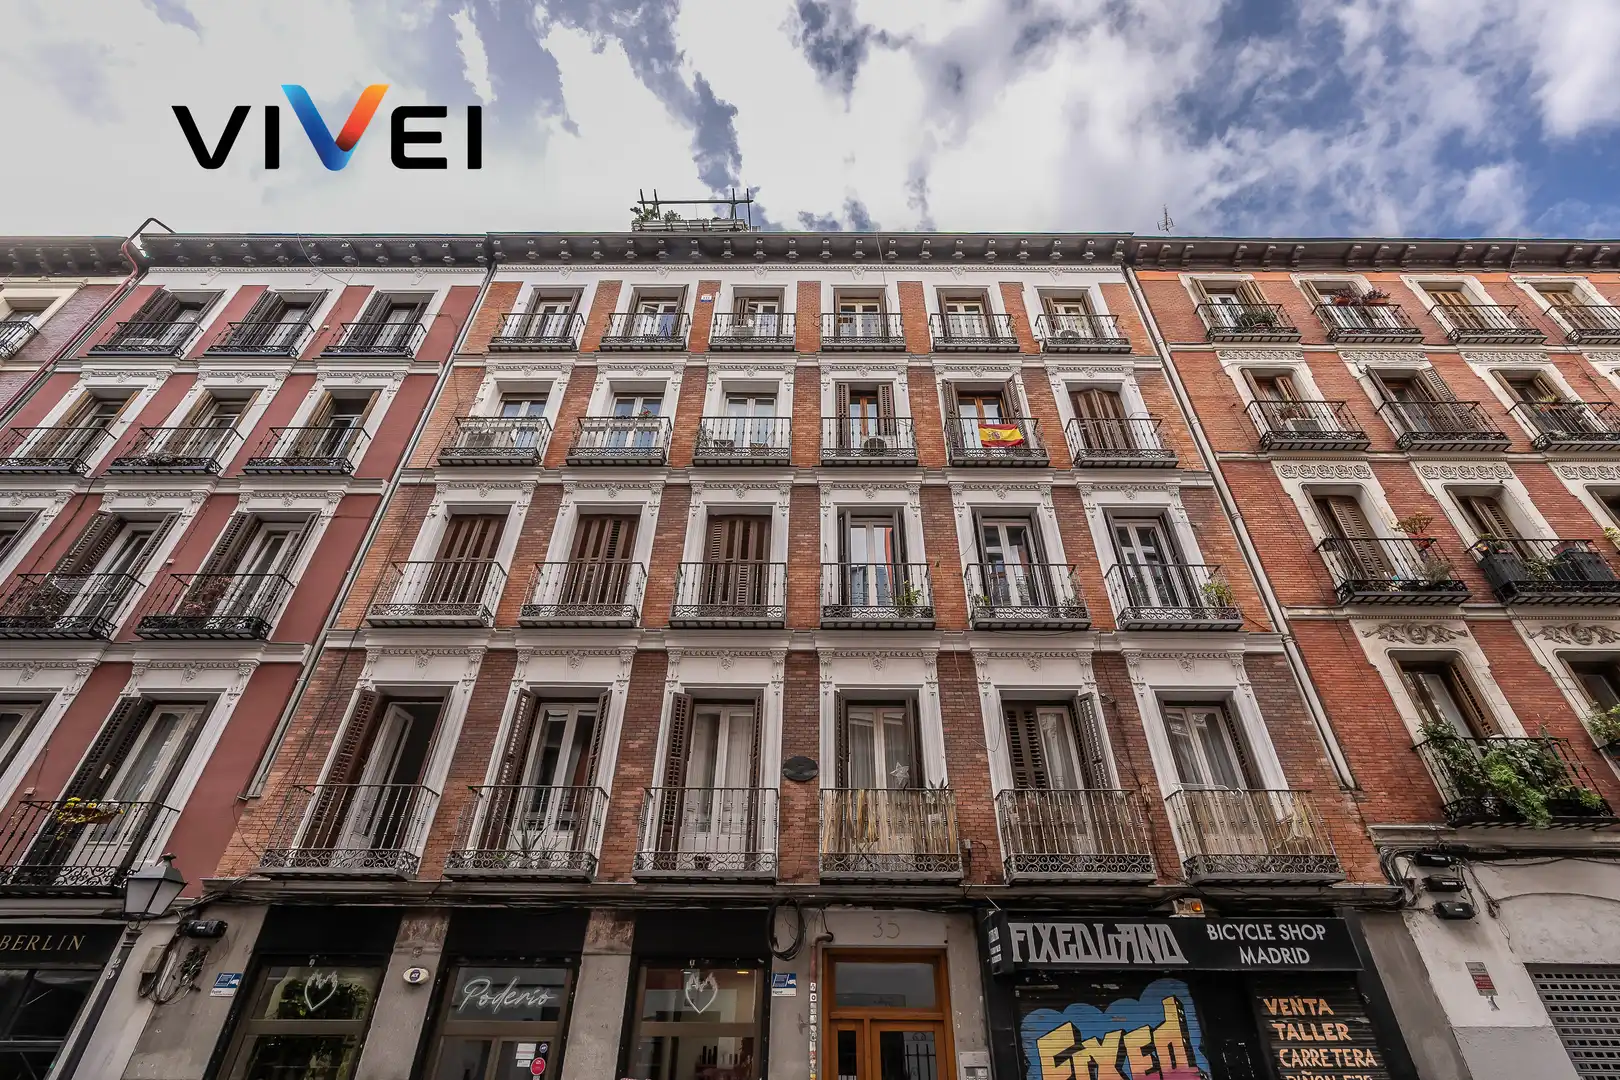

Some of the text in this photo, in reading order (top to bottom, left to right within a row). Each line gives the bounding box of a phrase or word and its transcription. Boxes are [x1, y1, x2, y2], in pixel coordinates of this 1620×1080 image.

[872, 915, 900, 939] 35
[1206, 923, 1327, 941] BICYCLE SHOP
[0, 934, 86, 951] BERLIN
[1008, 922, 1189, 964] FIXEDLAND
[1239, 946, 1310, 966] MADRID
[1263, 998, 1335, 1016] VENTA
[1271, 1023, 1353, 1041] TALLER
[1279, 1048, 1378, 1068] CARRETERA
